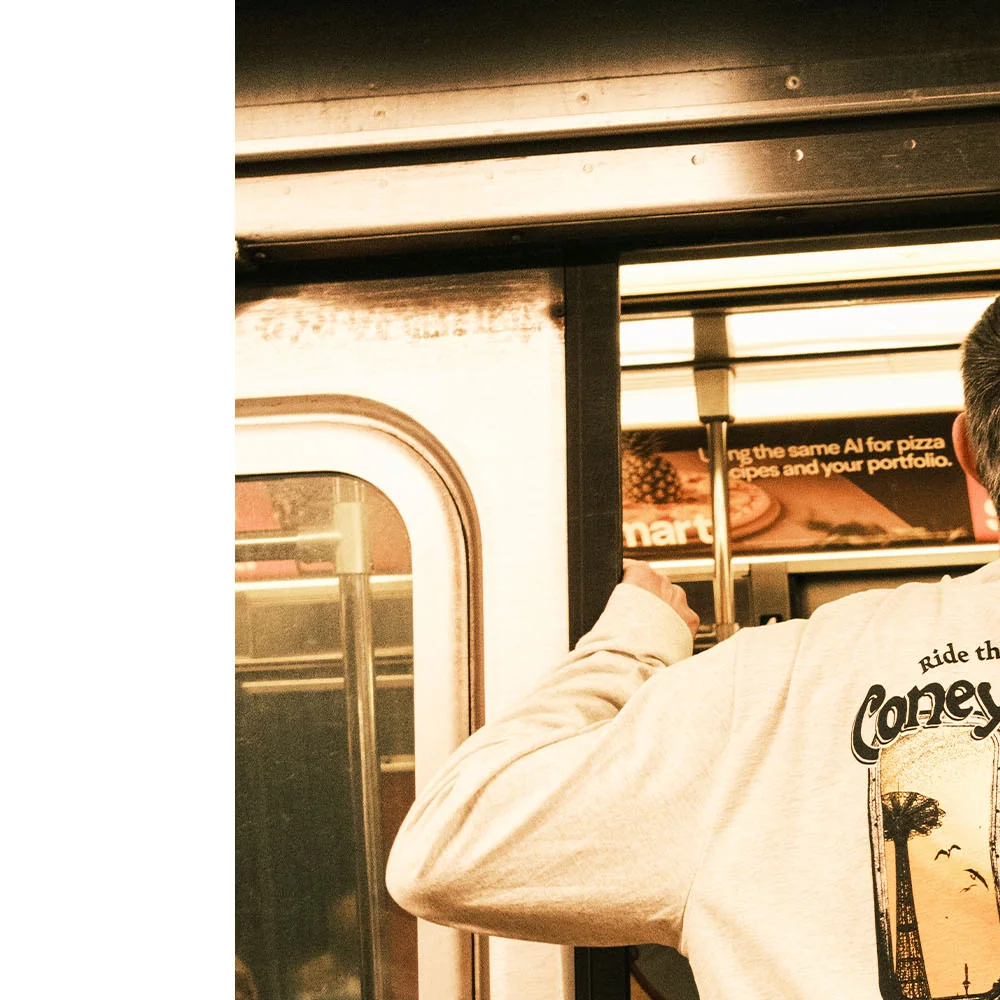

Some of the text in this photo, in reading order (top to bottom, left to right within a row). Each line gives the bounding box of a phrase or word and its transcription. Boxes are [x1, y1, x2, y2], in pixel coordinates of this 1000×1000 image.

[752, 443, 786, 460] the
[787, 443, 841, 458] same
[844, 437, 864, 454] AI
[866, 436, 894, 452] for
[897, 435, 946, 455] pizza
[783, 459, 819, 477] and
[821, 459, 864, 478] your
[867, 452, 953, 475] portfolio.
[622, 513, 713, 548] mart
[918, 643, 969, 674] Ride
